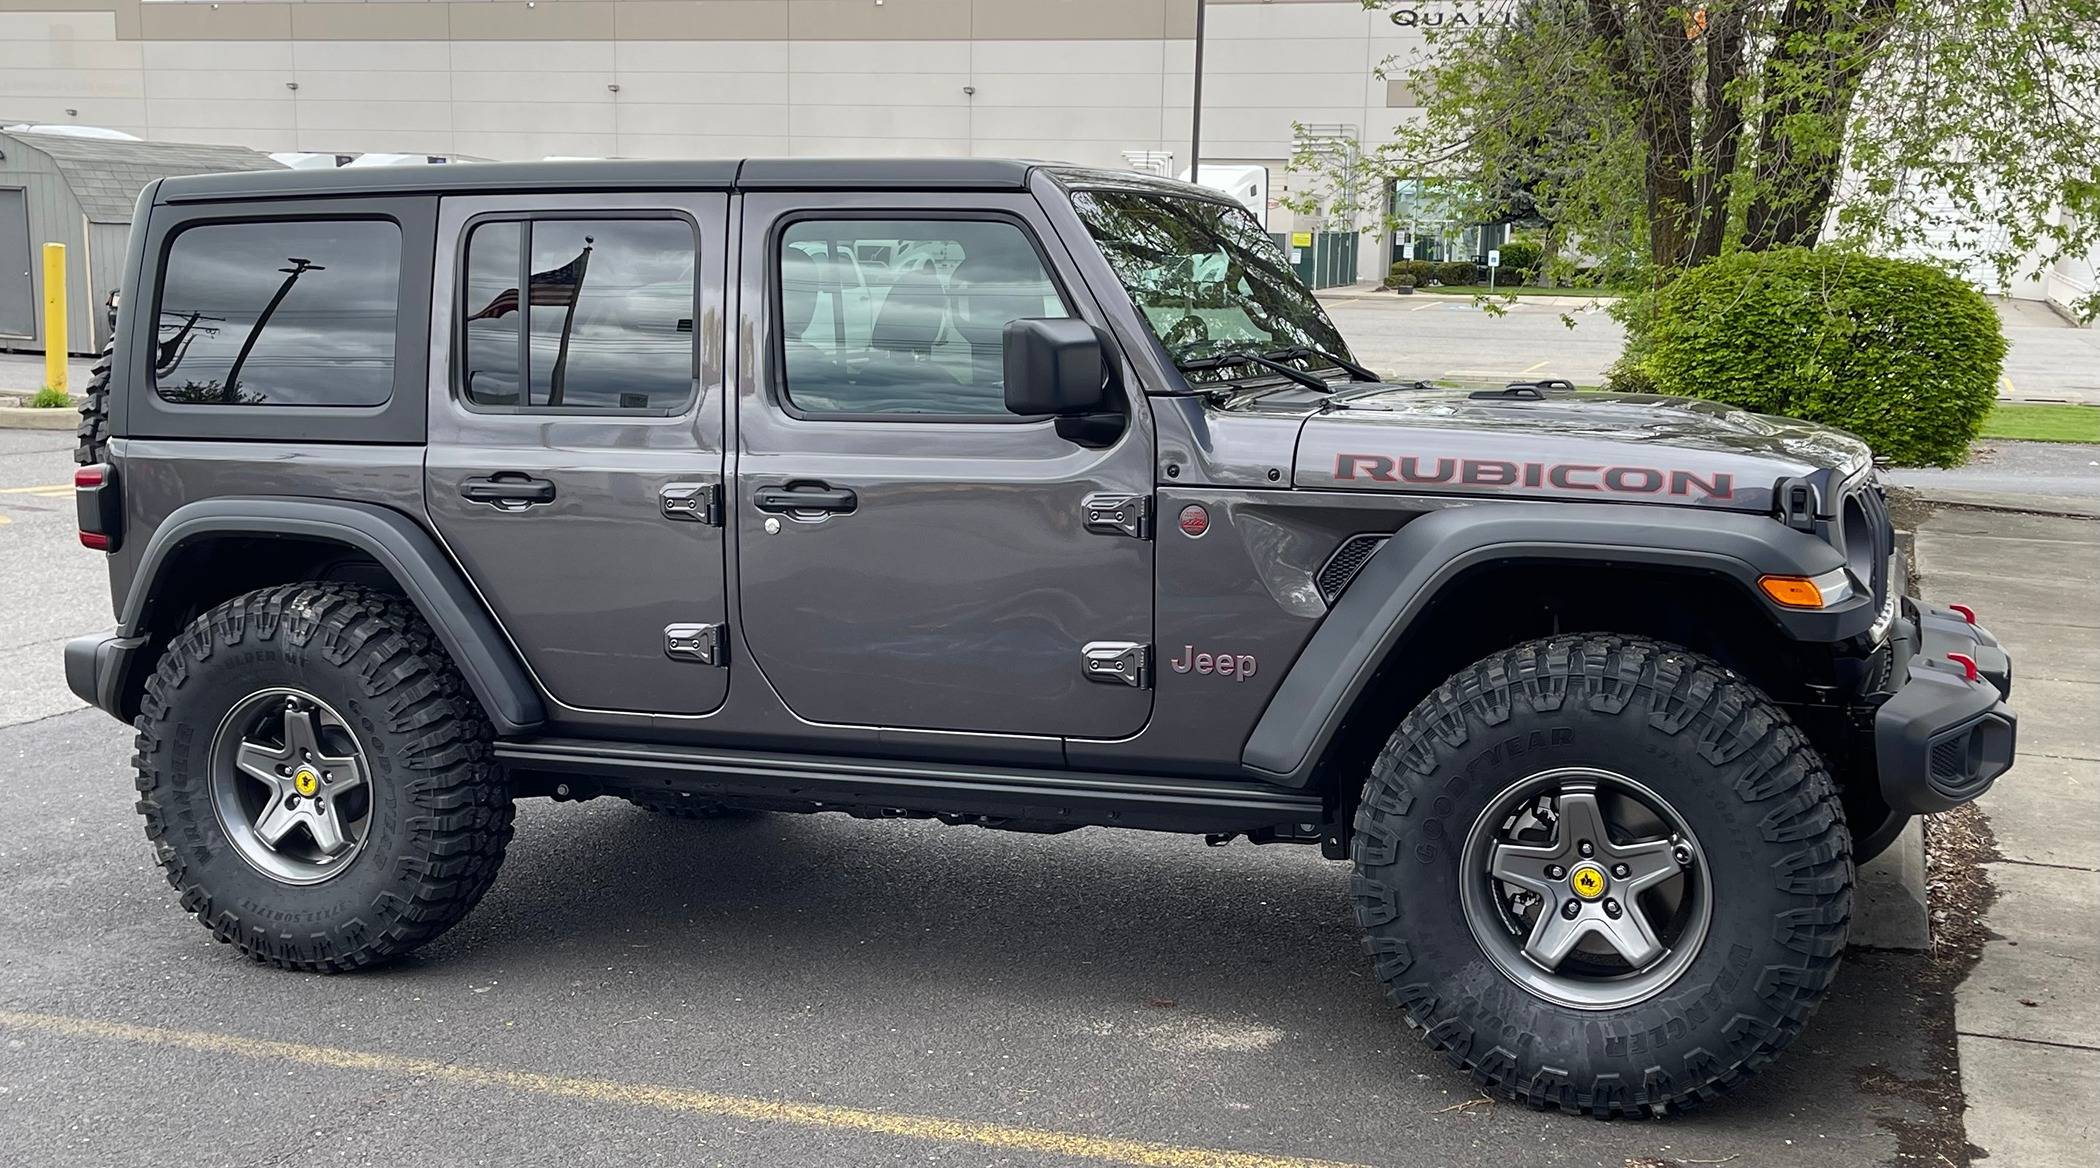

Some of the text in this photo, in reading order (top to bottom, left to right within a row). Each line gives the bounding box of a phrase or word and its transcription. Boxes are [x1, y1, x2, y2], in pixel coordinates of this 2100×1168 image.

[1335, 453, 1733, 498] RUBICON
[1170, 645, 1257, 682] Jeep
[1413, 726, 1576, 864] GOODYEAR
[1605, 941, 1753, 1058] WRANGLER
